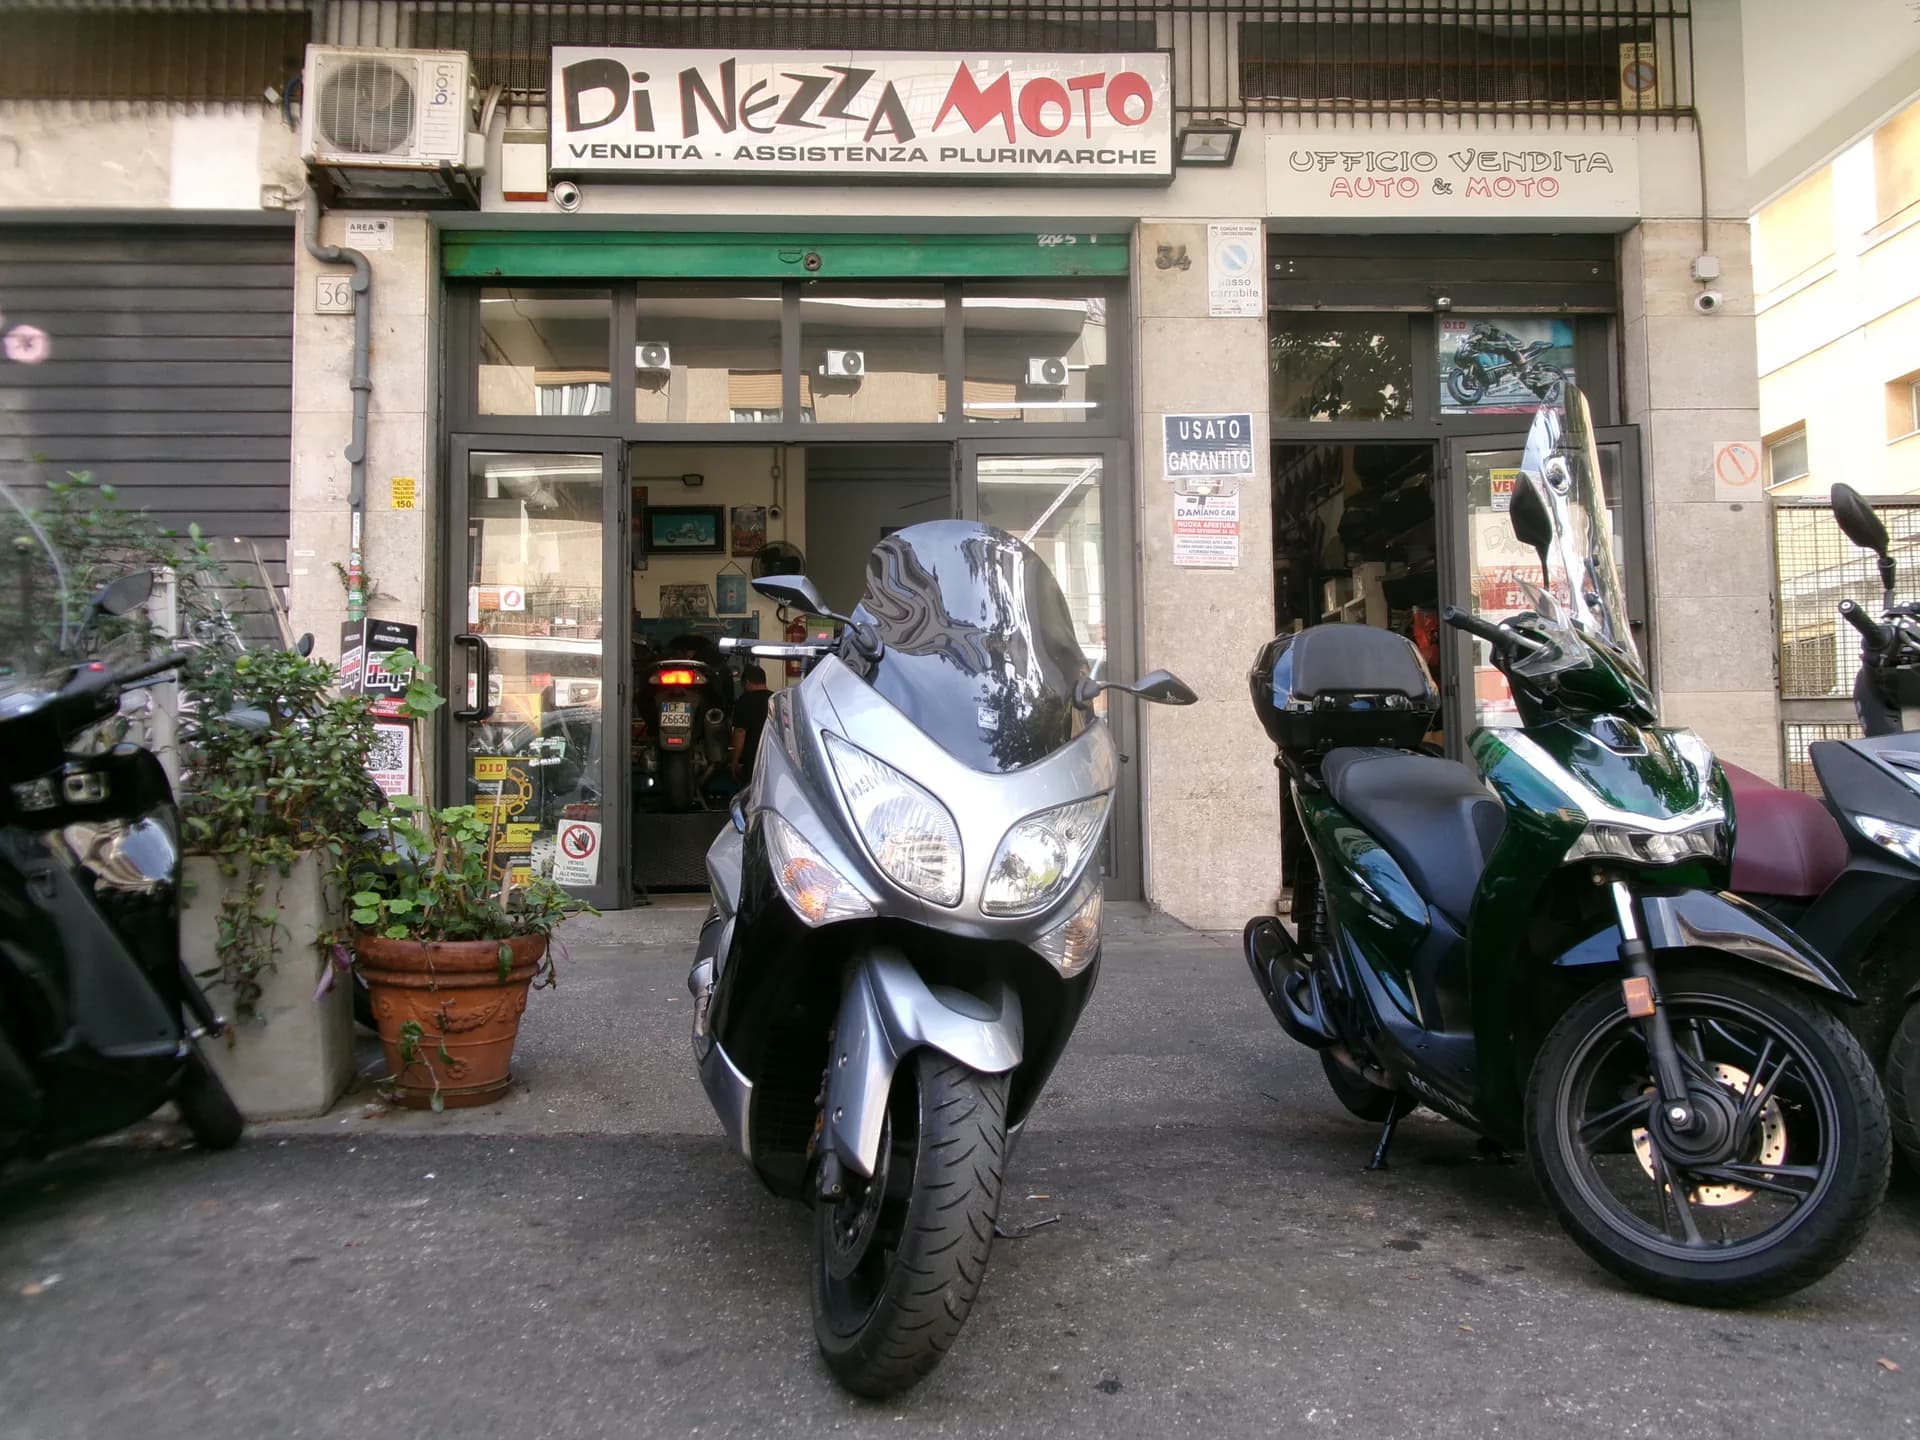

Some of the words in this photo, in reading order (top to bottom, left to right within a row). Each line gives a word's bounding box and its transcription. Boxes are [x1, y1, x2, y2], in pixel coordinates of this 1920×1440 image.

[562, 58, 655, 133] Di
[931, 59, 1153, 144] MOTO
[568, 144, 703, 160] VENDITA
[733, 145, 928, 162] ASSISTENZA
[940, 147, 1157, 165] PLURIMARCHE
[1289, 151, 1438, 173] UFFICIO
[1448, 148, 1614, 174] VENDITA
[1329, 176, 1420, 199] AUTO
[1432, 177, 1453, 196] &
[1465, 176, 1560, 199] MOTO
[350, 223, 374, 231] AREA
[319, 281, 349, 306] 36
[1179, 419, 1240, 440] USATO
[1168, 450, 1250, 472] GARANTITO
[1177, 507, 1220, 517] DAMIANO
[1221, 509, 1236, 517] CAR
